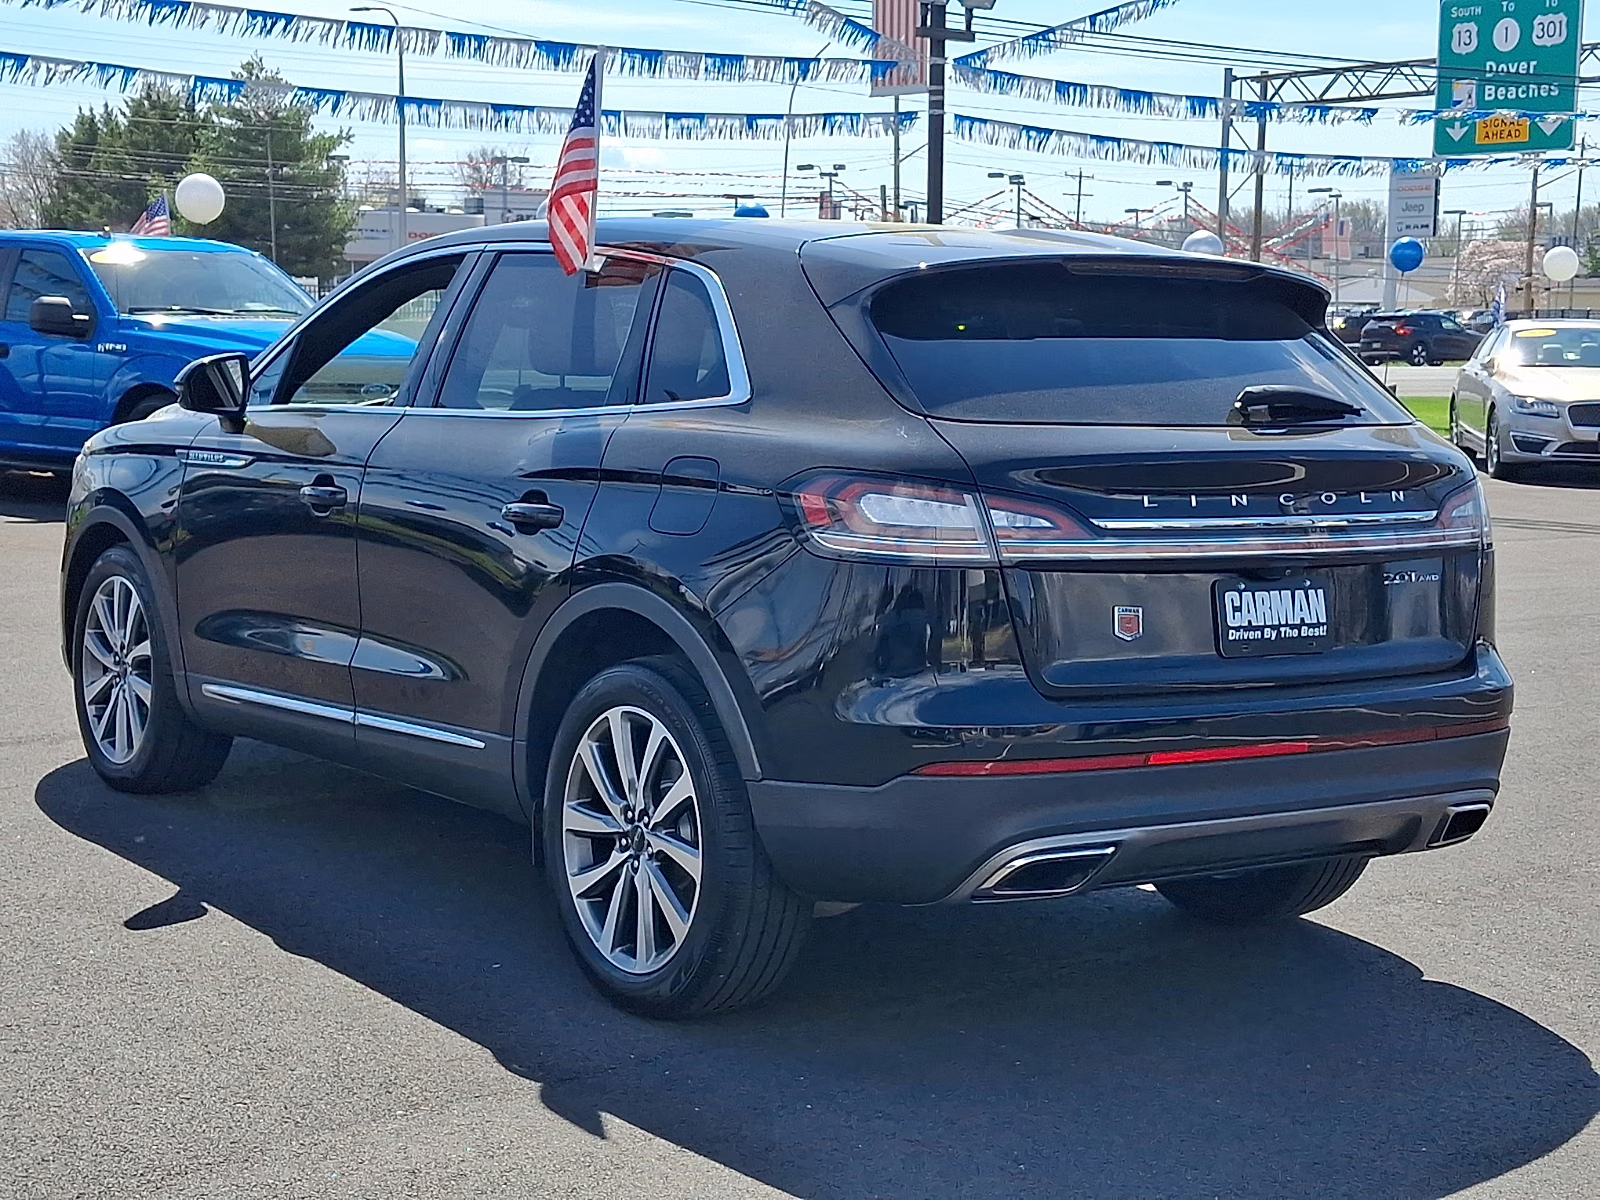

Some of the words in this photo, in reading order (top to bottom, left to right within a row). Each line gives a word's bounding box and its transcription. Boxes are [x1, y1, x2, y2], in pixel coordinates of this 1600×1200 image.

[1451, 6, 1482, 18] SOUTH
[1457, 29, 1473, 48] 13
[1504, 26, 1509, 44] 1
[1536, 20, 1563, 40] 301
[1485, 60, 1538, 78] Dover
[1484, 82, 1560, 101] Beaches
[1483, 129, 1522, 140] AHEAD
[1401, 201, 1425, 213] Jeep
[1143, 490, 1405, 508] LINCOLN
[1224, 588, 1328, 627] CARMAN
[1228, 629, 1262, 641] Driven
[1263, 627, 1278, 640] By
[1279, 626, 1299, 638] The
[1300, 625, 1328, 637] Best!
